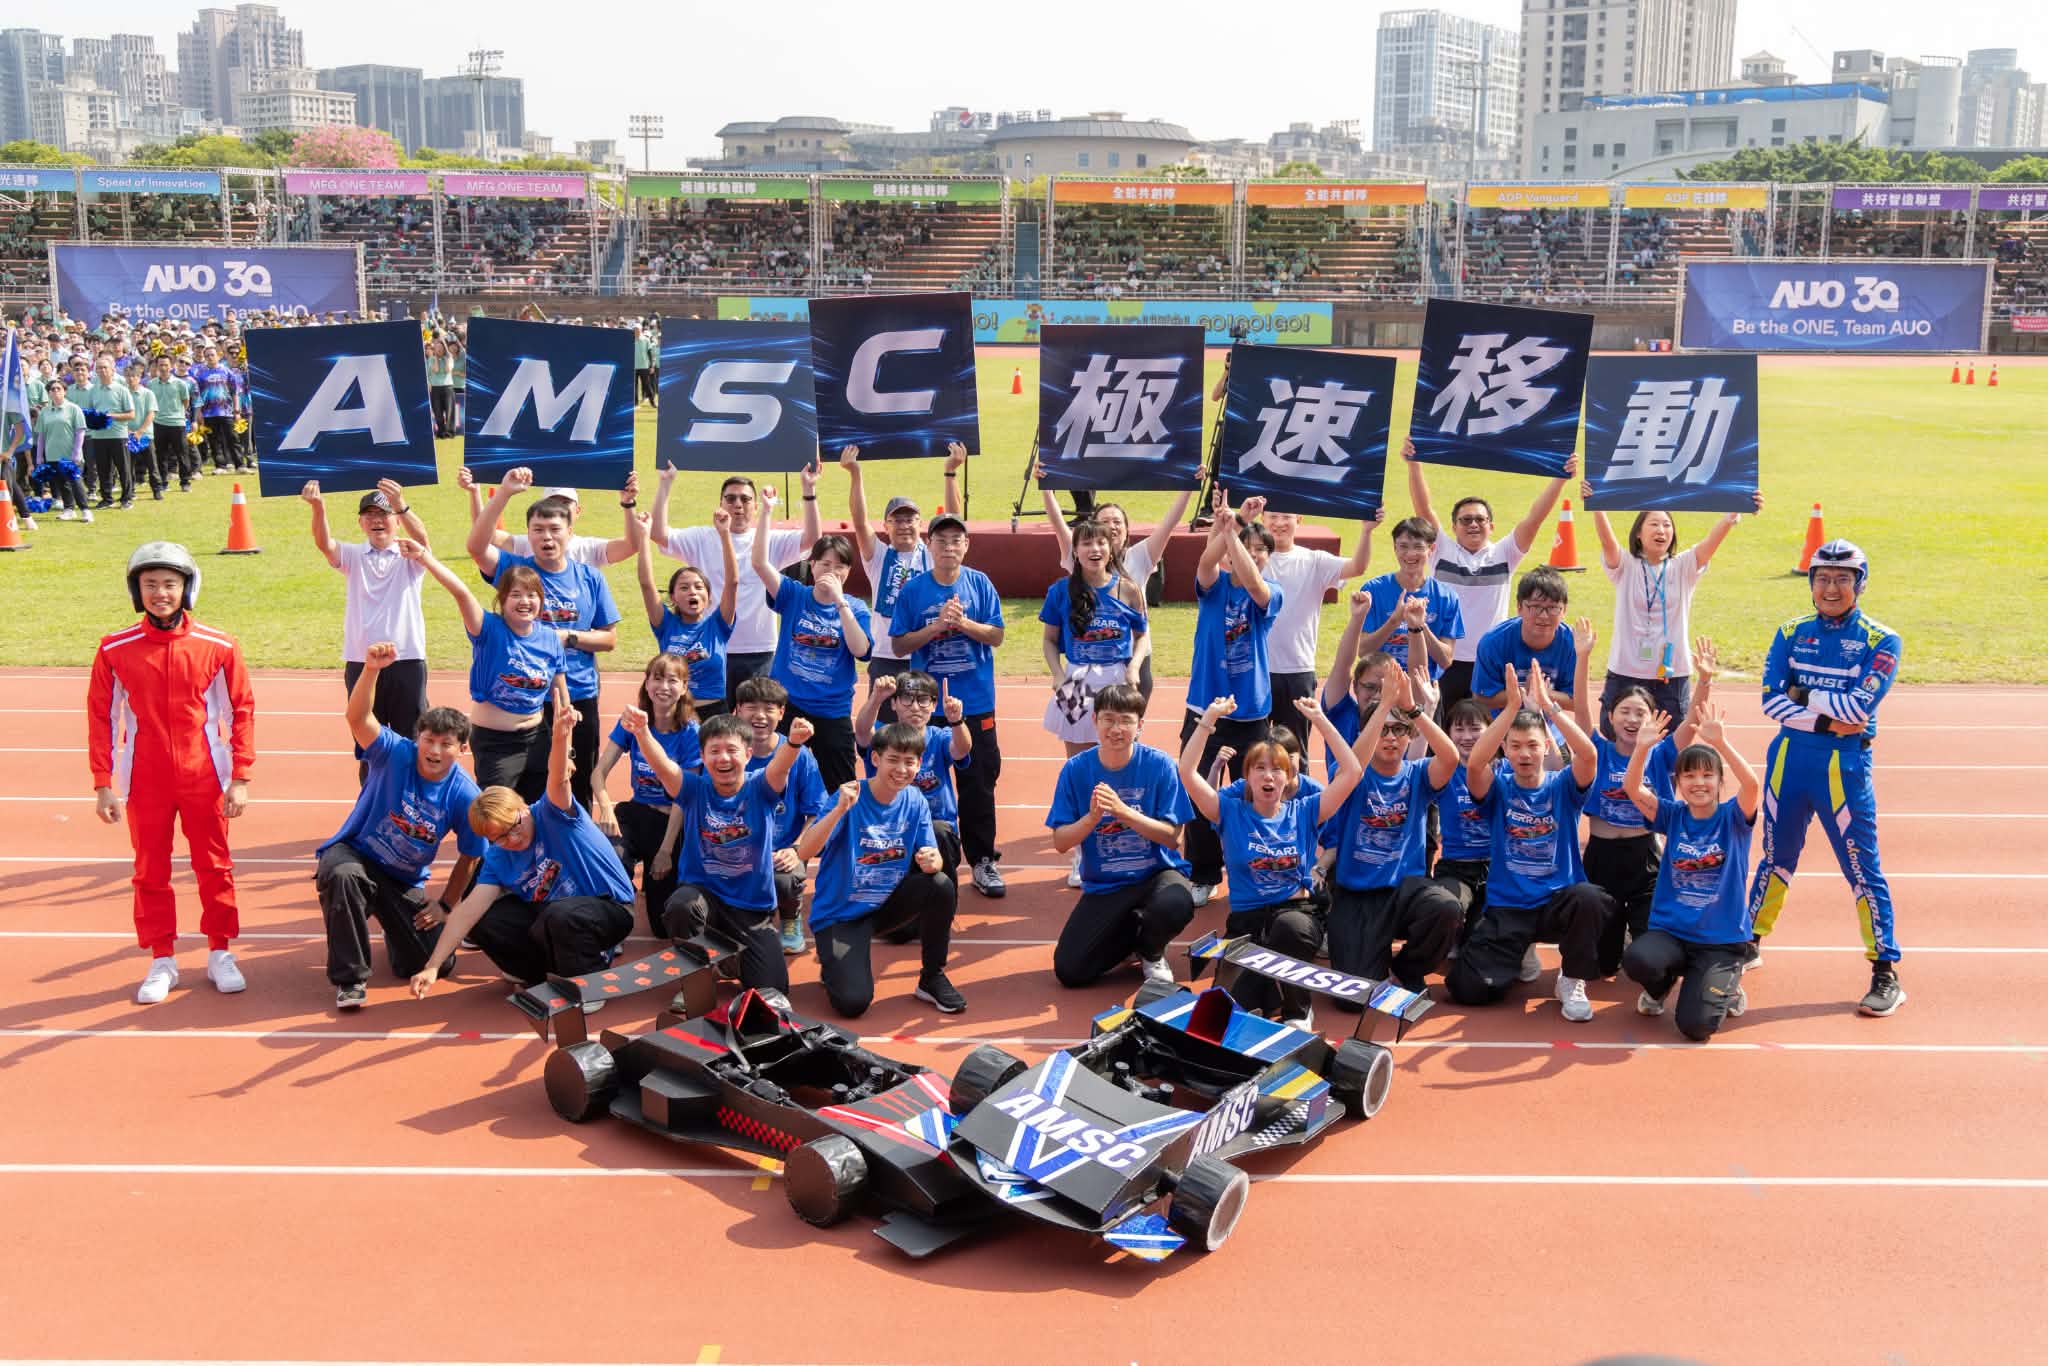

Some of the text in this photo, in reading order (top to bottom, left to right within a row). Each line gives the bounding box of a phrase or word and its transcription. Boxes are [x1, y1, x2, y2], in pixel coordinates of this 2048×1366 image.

[97, 177, 207, 190] Speed of Innovation
[311, 180, 405, 193] MFG ONE TEAM
[466, 181, 563, 193] MFG ONE TEAM
[135, 303, 165, 319] the
[142, 264, 216, 293] AUO
[1768, 280, 1846, 309] AUO
[1733, 320, 1932, 337] Be the ONE, Team AUO
[278, 354, 409, 452] A
[479, 358, 617, 444] M
[687, 359, 798, 443] S
[846, 328, 946, 415] C
[1054, 354, 1185, 461] 極
[1431, 333, 1572, 436] 移
[1238, 377, 1375, 483] 速
[1603, 377, 1741, 485] 動
[1799, 674, 1848, 690] AMSC
[1238, 950, 1372, 997] AMSC
[995, 1090, 1148, 1169] AMSC
[1187, 1083, 1260, 1168] AMSC
